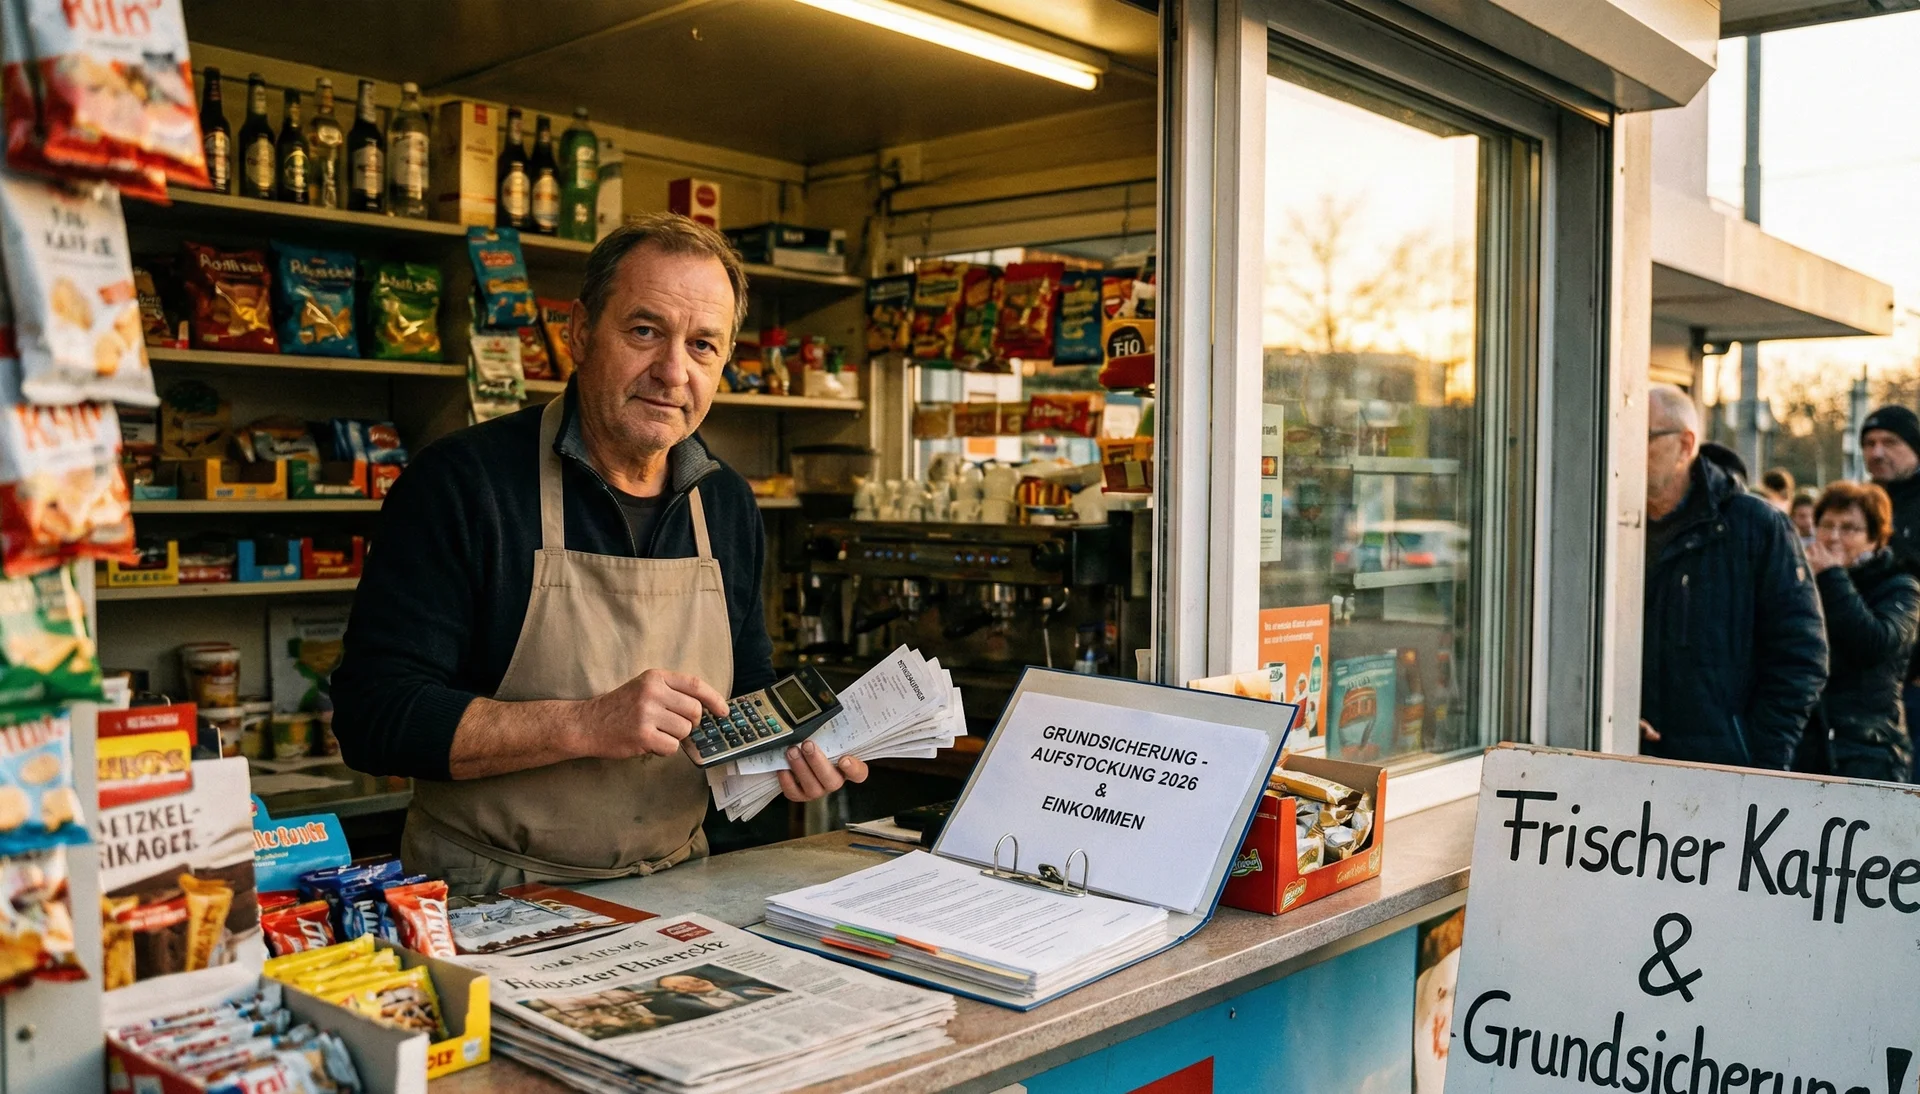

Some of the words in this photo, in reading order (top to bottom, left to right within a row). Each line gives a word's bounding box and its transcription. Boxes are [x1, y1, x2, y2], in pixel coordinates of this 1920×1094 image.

[1042, 725, 1198, 766] GRUNDSICHERUNG
[1031, 746, 1156, 783] AUFSTOCKUNG
[1158, 771, 1199, 792] 2026
[1095, 782, 1107, 798] &
[1041, 795, 1146, 831] EINKOMMEN
[1496, 789, 1726, 886] Frischer
[1738, 803, 1920, 924] Kaffee
[1638, 912, 1703, 1003] &
[1463, 990, 1913, 1094] Grundsicher!
